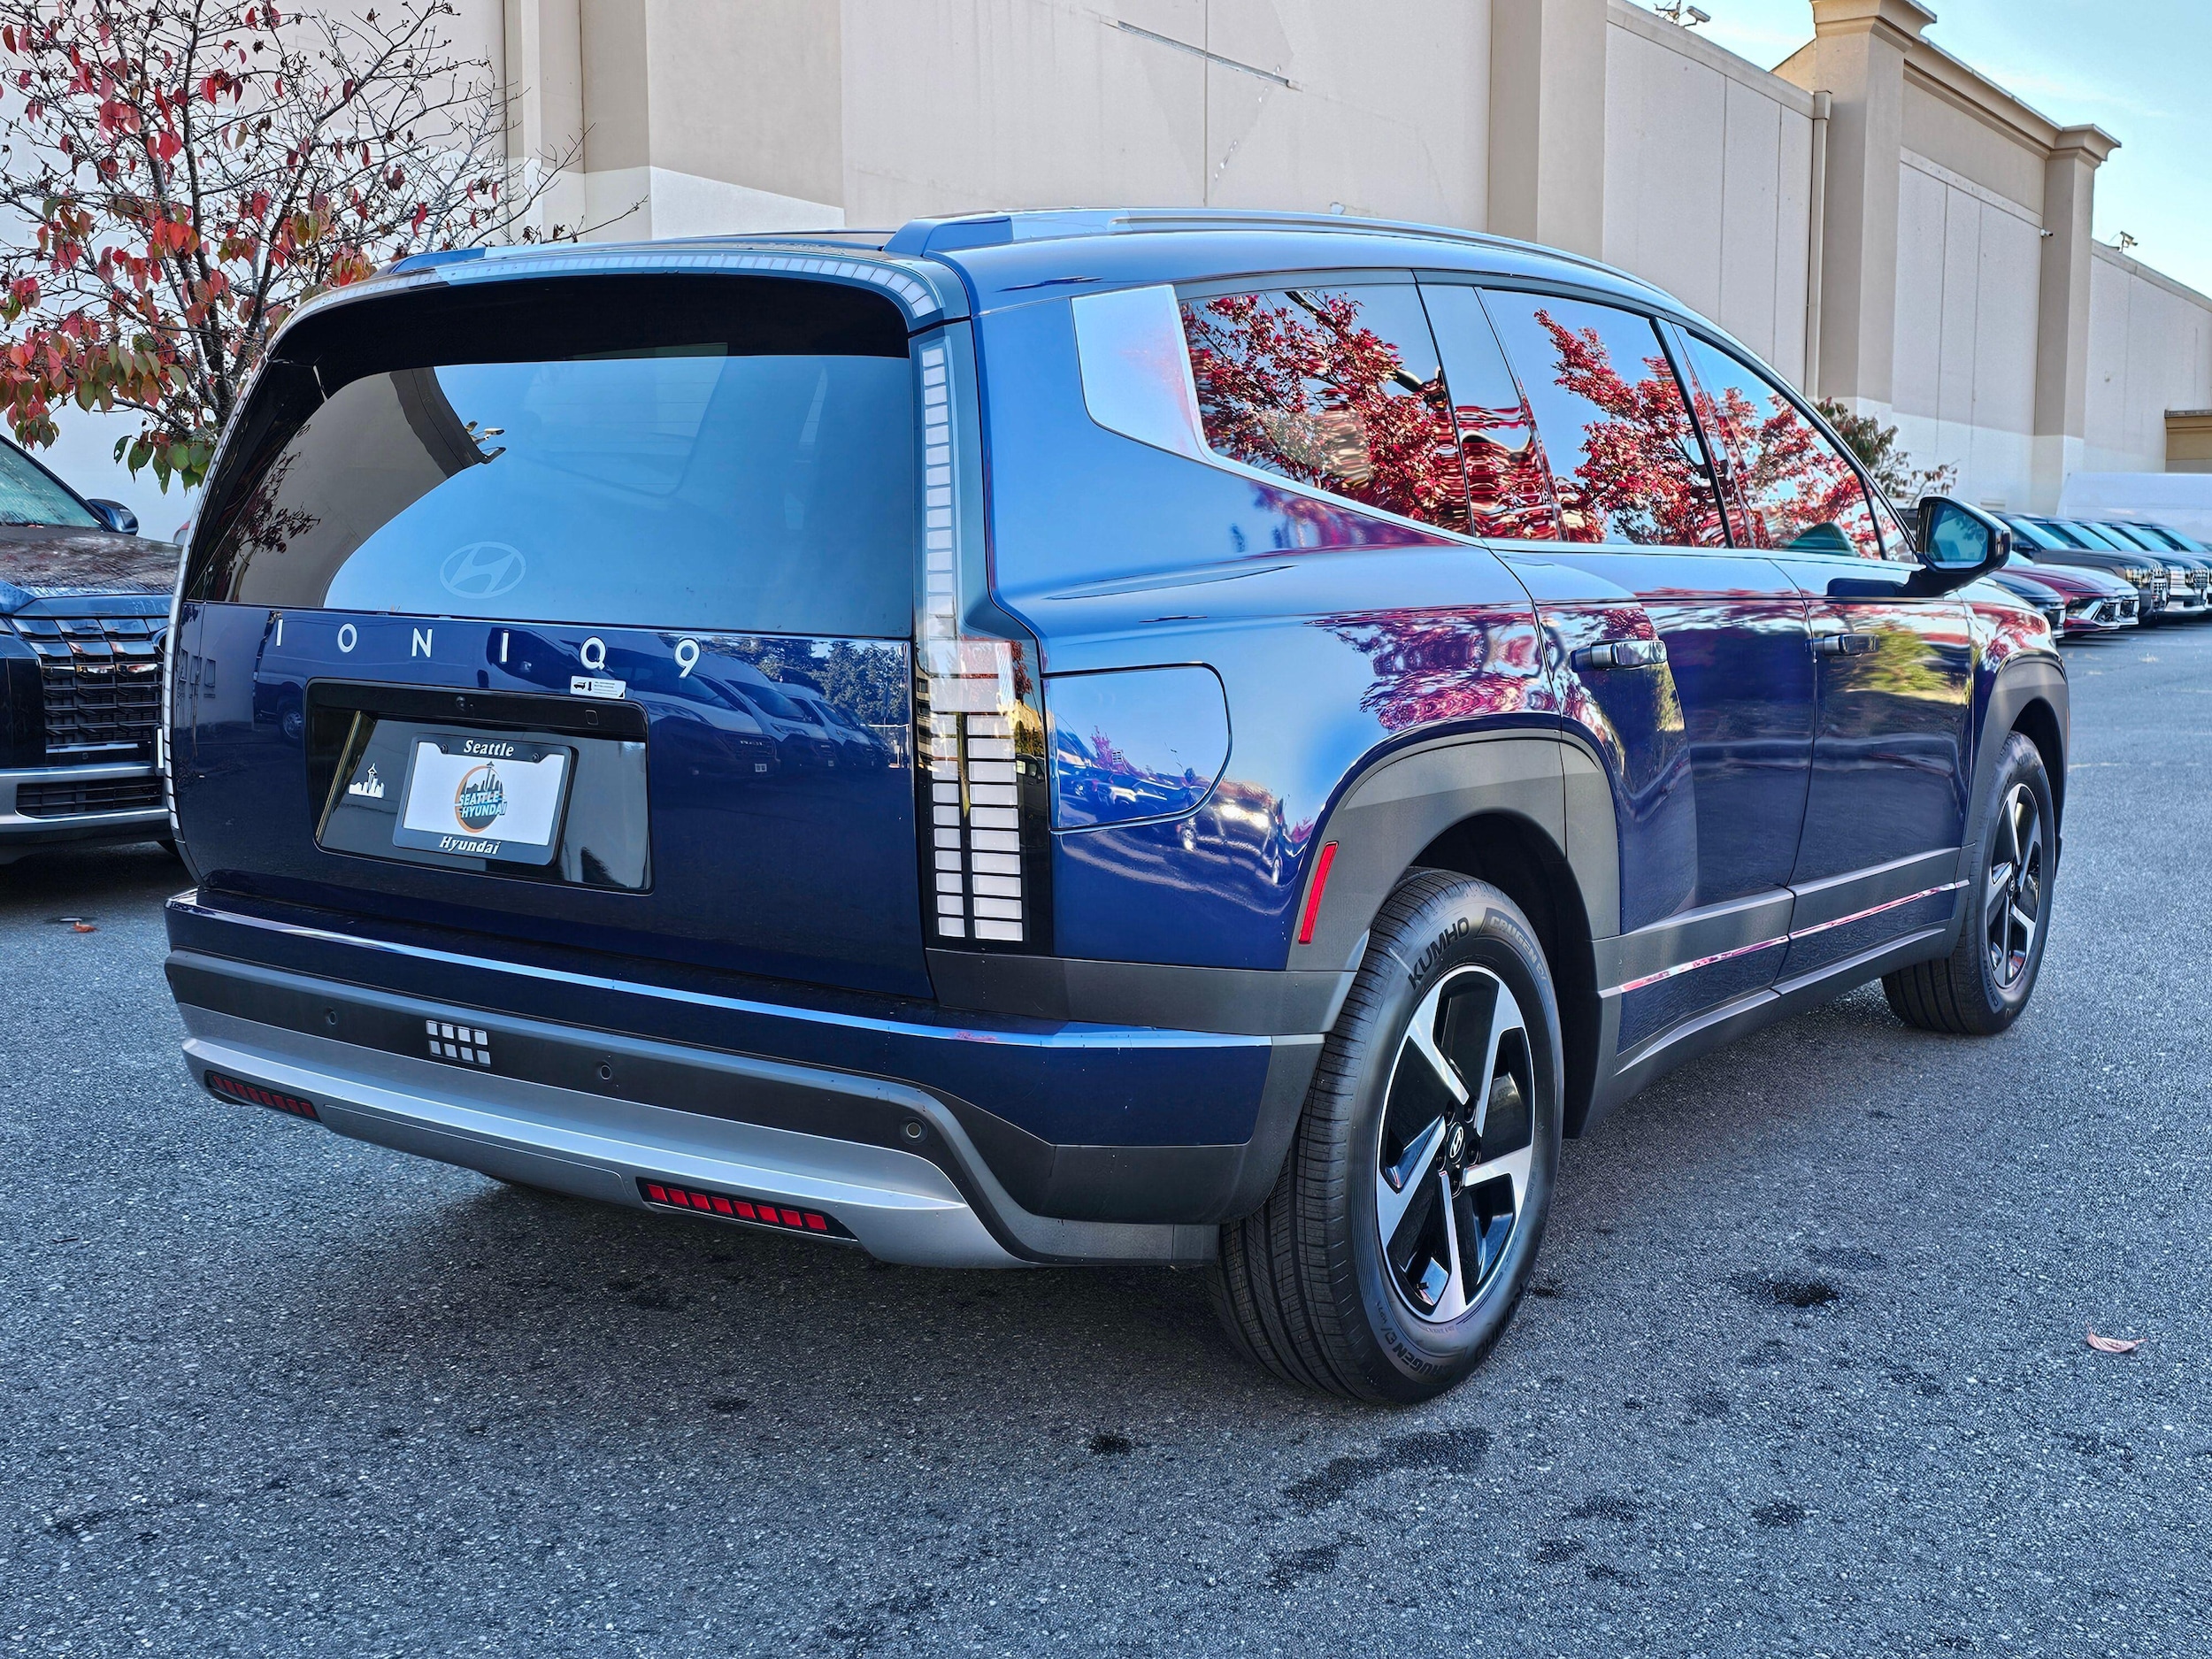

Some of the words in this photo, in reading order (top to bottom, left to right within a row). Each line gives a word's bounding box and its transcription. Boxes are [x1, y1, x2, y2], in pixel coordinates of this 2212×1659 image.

[276, 618, 605, 671] IONIQ
[674, 638, 702, 679] 9
[464, 740, 514, 757] Seattle
[459, 790, 500, 806] SEATTLE
[461, 800, 508, 818] HYUNDAI
[439, 835, 502, 855] Hyundai
[1489, 915, 1538, 964] CRUGEN
[1408, 917, 1470, 991] KUMHO
